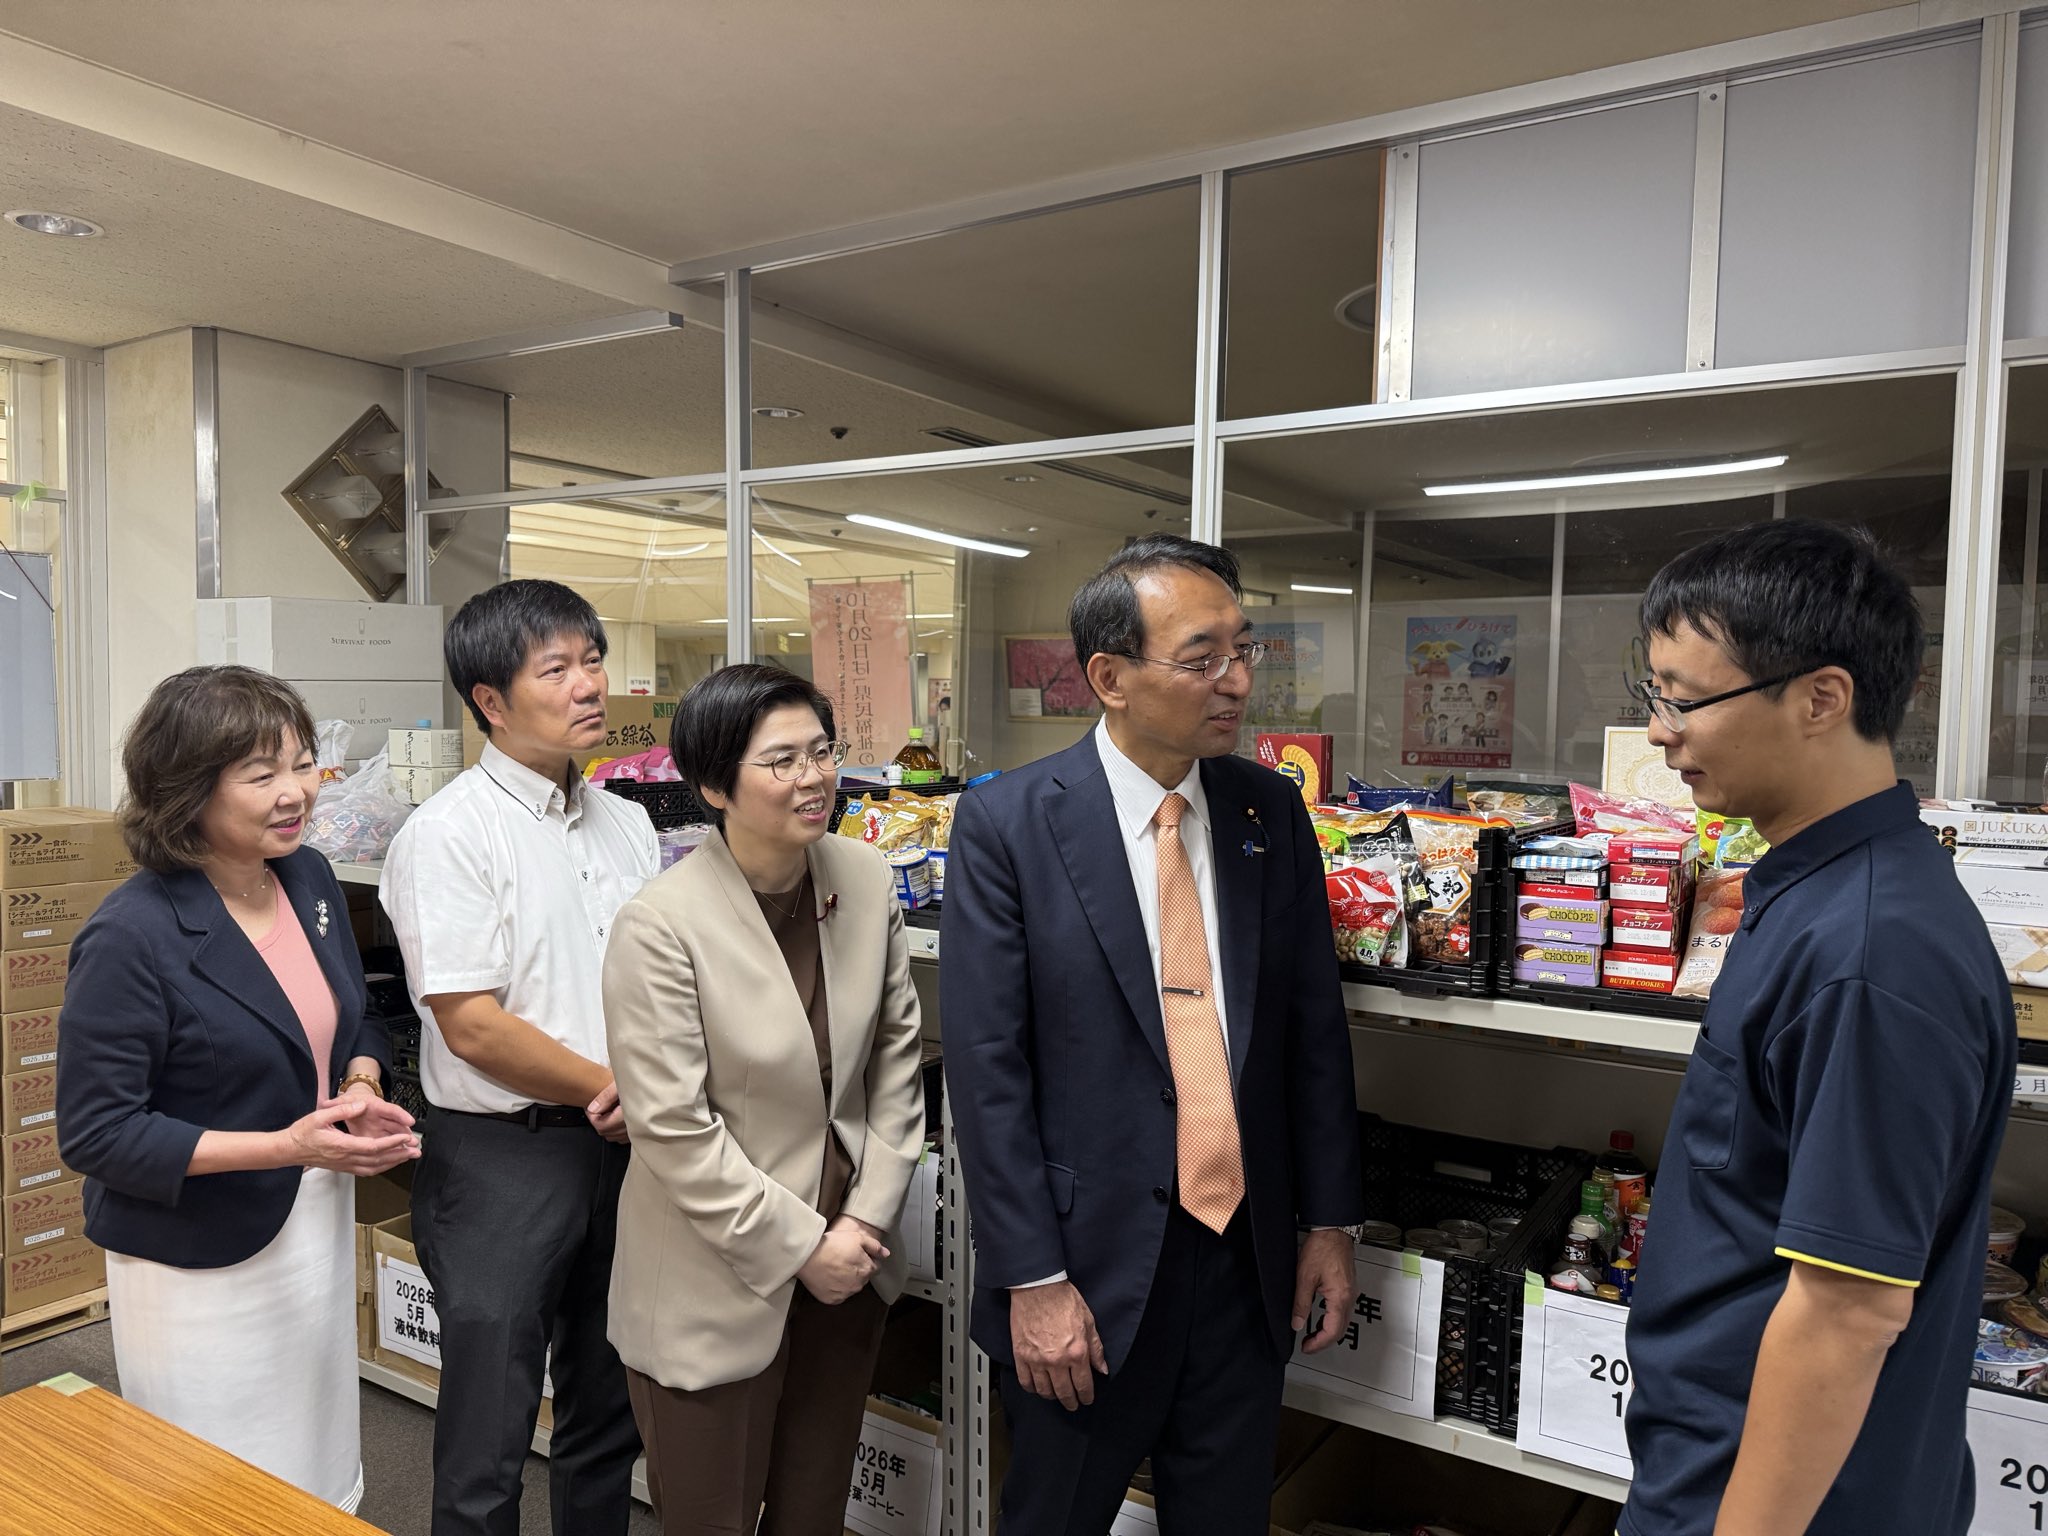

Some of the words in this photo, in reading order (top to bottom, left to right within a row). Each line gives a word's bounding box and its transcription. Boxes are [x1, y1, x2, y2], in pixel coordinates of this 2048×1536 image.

[1411, 623, 1455, 636] やさしさ
[1468, 622, 1512, 633] ひろげて
[331, 637, 365, 645] SURVIVAL
[1618, 875, 1659, 885] チョコチップ
[1549, 910, 1580, 921] CHOCO
[1580, 912, 1594, 922] PIE
[1621, 918, 1663, 929] チョコチップ
[1544, 951, 1574, 962] CHOCO
[1574, 954, 1589, 964] PIE
[1609, 977, 1635, 986] BUTTER
[1636, 980, 1665, 988] COOKIES
[21, 1170, 60, 1186] 2025.12.17
[25, 1228, 63, 1244] 2025.12.17
[396, 1279, 435, 1309] 2026年
[407, 1302, 425, 1326] 5月
[394, 1316, 440, 1349] 液体飲料
[1589, 1353, 1630, 1386] 20
[1611, 1391, 1623, 1418] 1
[860, 1466, 886, 1497] 5月
[1999, 1457, 2048, 1495] 20
[2028, 1500, 2043, 1532] 1
